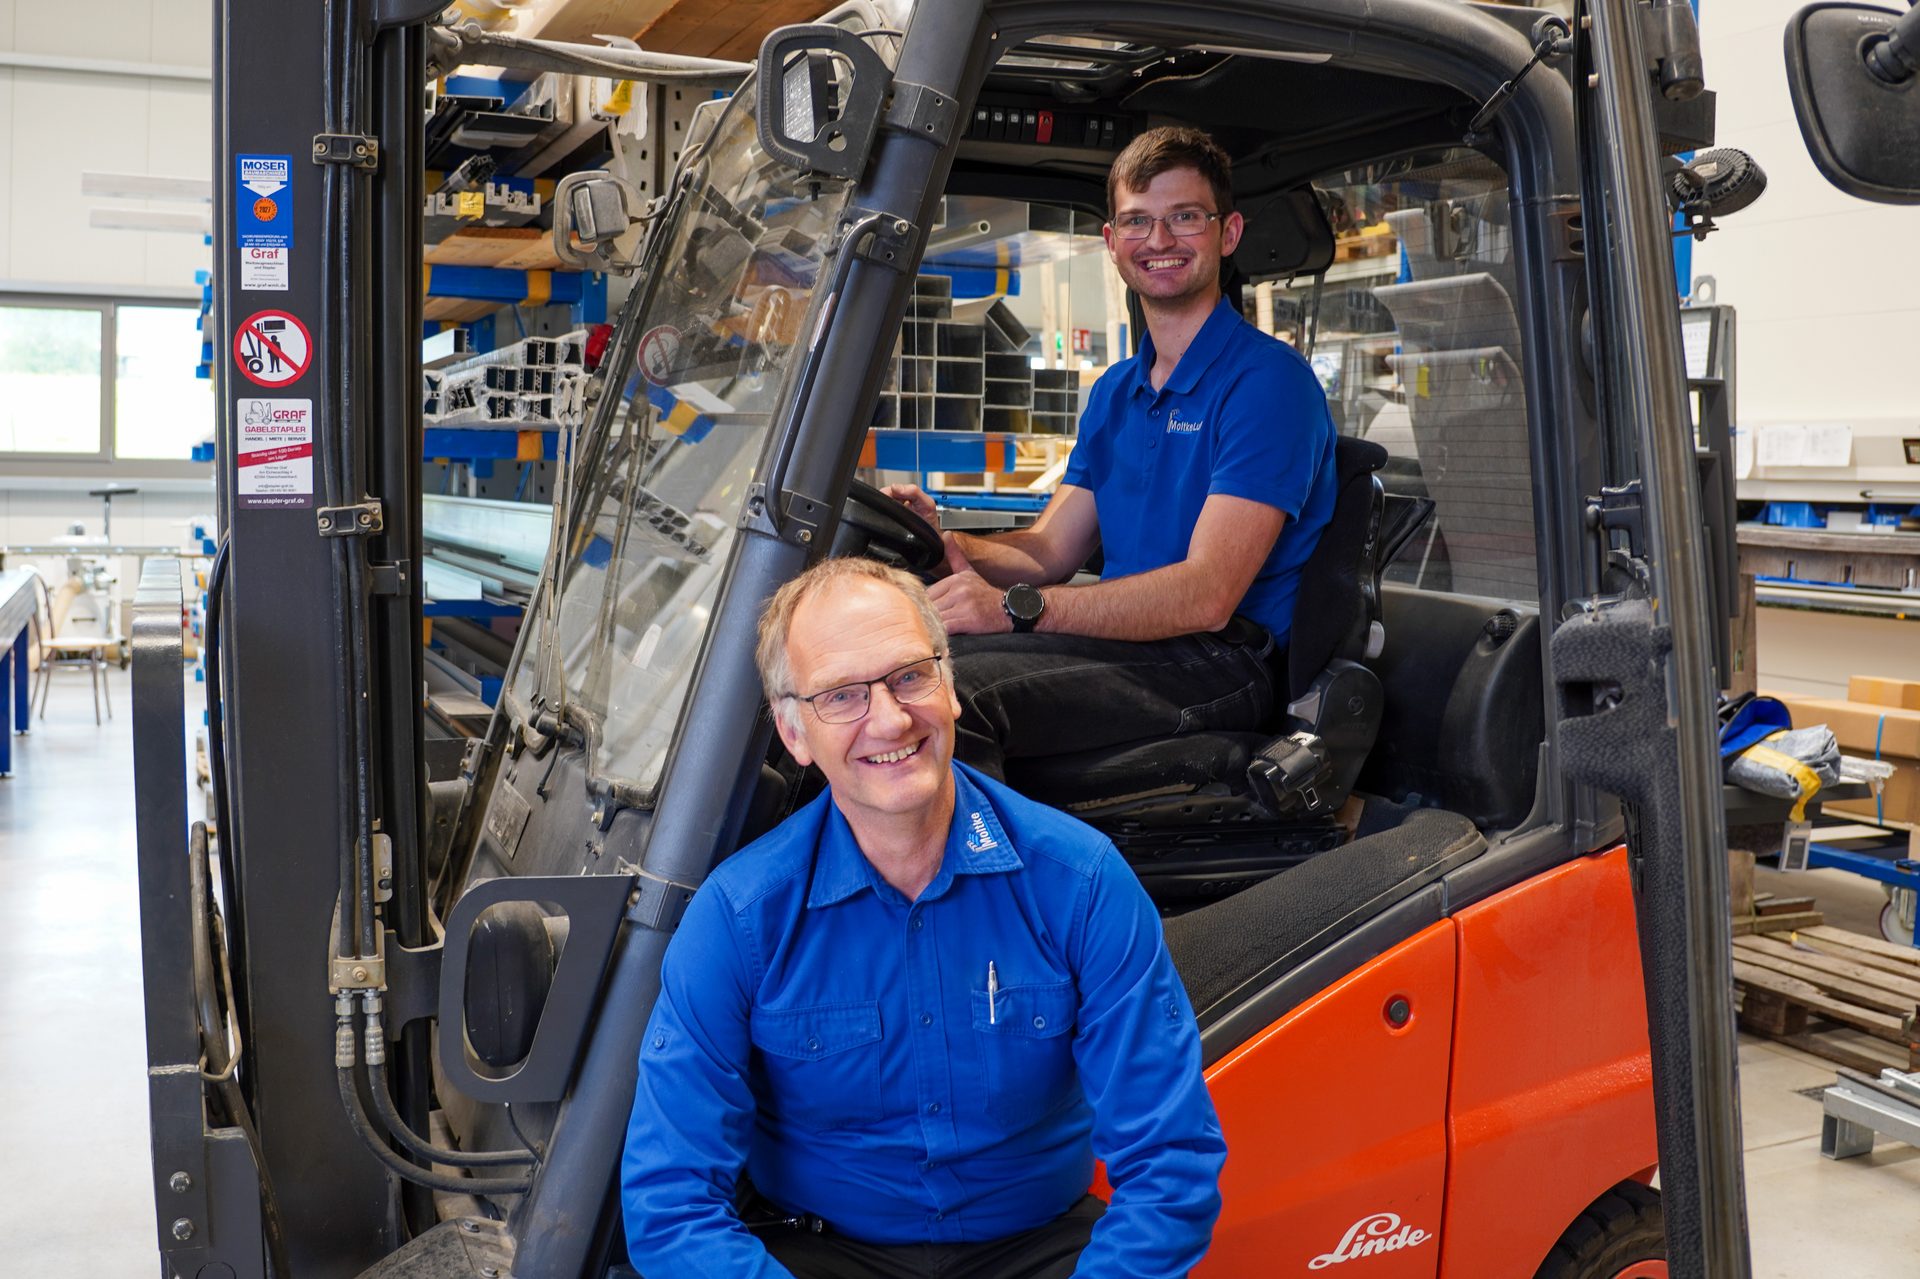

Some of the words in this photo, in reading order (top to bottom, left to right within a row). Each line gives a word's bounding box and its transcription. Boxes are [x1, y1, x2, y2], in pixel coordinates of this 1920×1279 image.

[243, 161, 286, 170] MOSER
[251, 248, 279, 259] Graf
[273, 410, 307, 419] GRAF
[971, 812, 999, 849] Moltke
[1308, 1212, 1433, 1270] Linde
